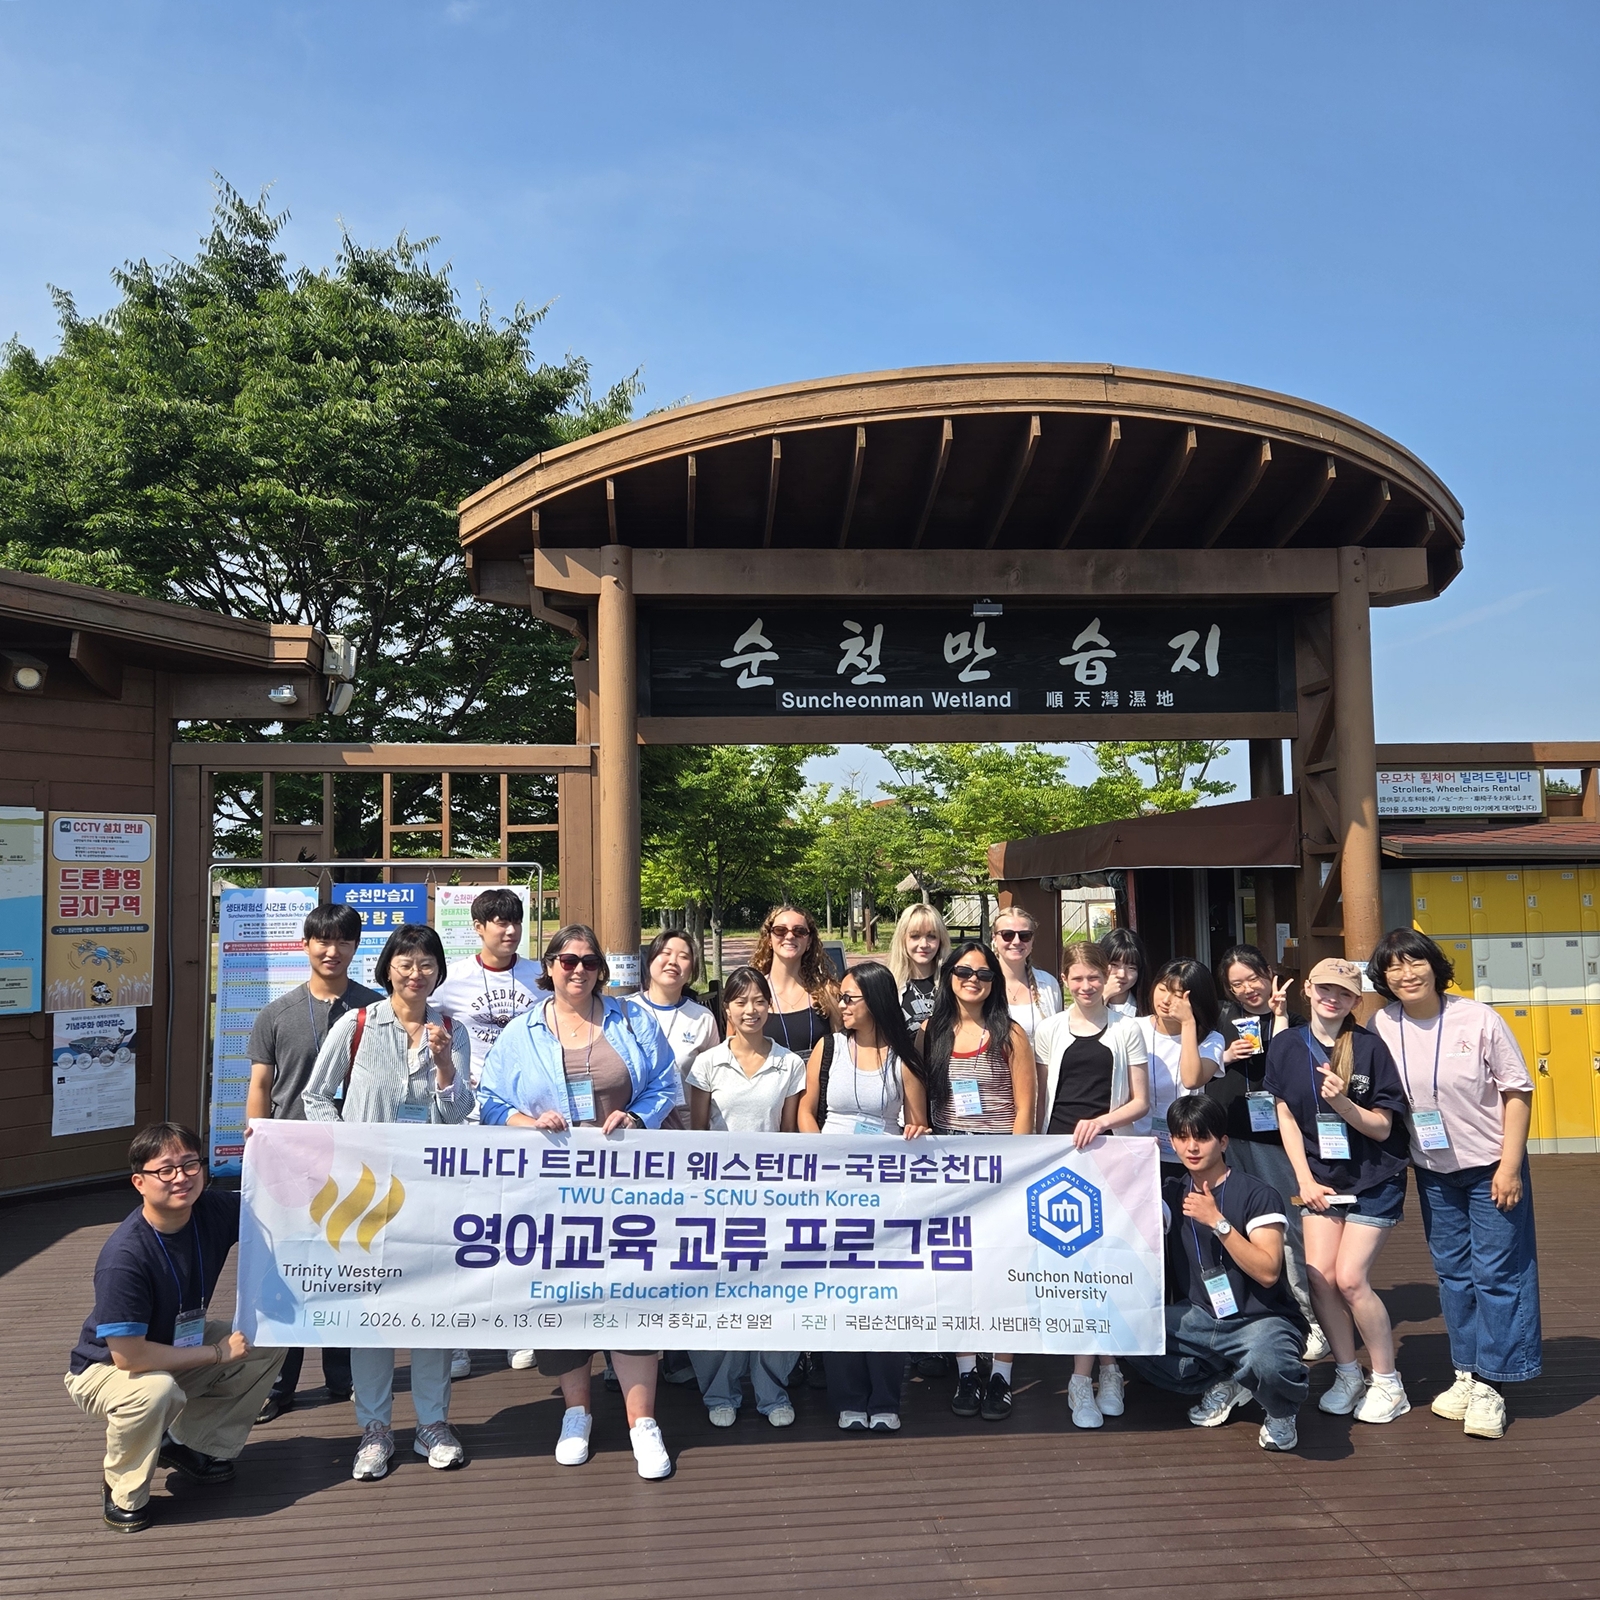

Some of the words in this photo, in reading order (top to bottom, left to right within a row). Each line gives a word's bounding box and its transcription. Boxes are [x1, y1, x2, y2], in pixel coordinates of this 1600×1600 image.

[720, 617, 1221, 688] 순천만습지
[781, 691, 923, 709] Suncheonman
[931, 691, 1012, 708] Wetland
[1045, 690, 1175, 708] 順天灣濕地
[1379, 773, 1416, 784] 유모차
[1420, 772, 1456, 784] 휠체어
[1460, 771, 1532, 784] 빌려드립니다
[1392, 785, 1434, 793] Strollers,
[1436, 785, 1490, 793] Wheelchairs
[1492, 784, 1521, 792] Rental
[73, 822, 101, 833] CCTV
[103, 822, 121, 834] 설치
[124, 823, 143, 834] 안내
[60, 868, 141, 890] 드론촬영
[345, 889, 414, 903] 순천만습지
[60, 895, 140, 917] 금지구역
[226, 902, 263, 913] 생태체험선
[265, 902, 287, 912] 시간표
[471, 989, 534, 1011] SPEEDWAY
[65, 1021, 95, 1031] 기념주화
[424, 1146, 528, 1179] 캐나다
[539, 1149, 674, 1180] 트리니티
[687, 1151, 1002, 1184] 웨스턴대-국립순천대
[1041, 1173, 1080, 1188] NATIONAL
[558, 1187, 605, 1204] TWU
[611, 1187, 685, 1206] Canada
[704, 1189, 758, 1206] SCNU
[763, 1189, 820, 1207] South
[826, 1189, 880, 1207] Korea
[1031, 1189, 1039, 1232] SUNCHON
[1084, 1185, 1100, 1234] UNIVERSITY
[453, 1213, 657, 1271] 영어교육
[670, 1216, 769, 1272] 교류
[781, 1215, 973, 1272] 프로그램
[283, 1264, 332, 1280] Trinity
[337, 1265, 402, 1279] Western
[1008, 1269, 1069, 1284] Sunchon
[1074, 1270, 1134, 1285] National
[301, 1279, 382, 1295] University
[531, 1281, 604, 1303] English
[610, 1281, 709, 1300] Education
[715, 1282, 807, 1303] Exchange
[814, 1283, 898, 1303] Program
[1035, 1286, 1107, 1302] University
[313, 1311, 340, 1327] 일시
[360, 1312, 405, 1327] 2026.
[412, 1313, 425, 1328] 6.
[431, 1313, 476, 1329] 12.(금)
[494, 1314, 507, 1328] 6.
[513, 1314, 532, 1328] 13.
[537, 1313, 562, 1329] (토)
[592, 1314, 619, 1329] 장소
[637, 1313, 664, 1329] 지역
[668, 1314, 712, 1330] 중학교,
[716, 1314, 742, 1329] 순천
[746, 1314, 772, 1330] 일원
[801, 1315, 828, 1330] 주관
[845, 1315, 937, 1331] 국립순천대학교
[989, 1317, 1041, 1332] 사범대학
[1045, 1318, 1111, 1334] 영어교육과
